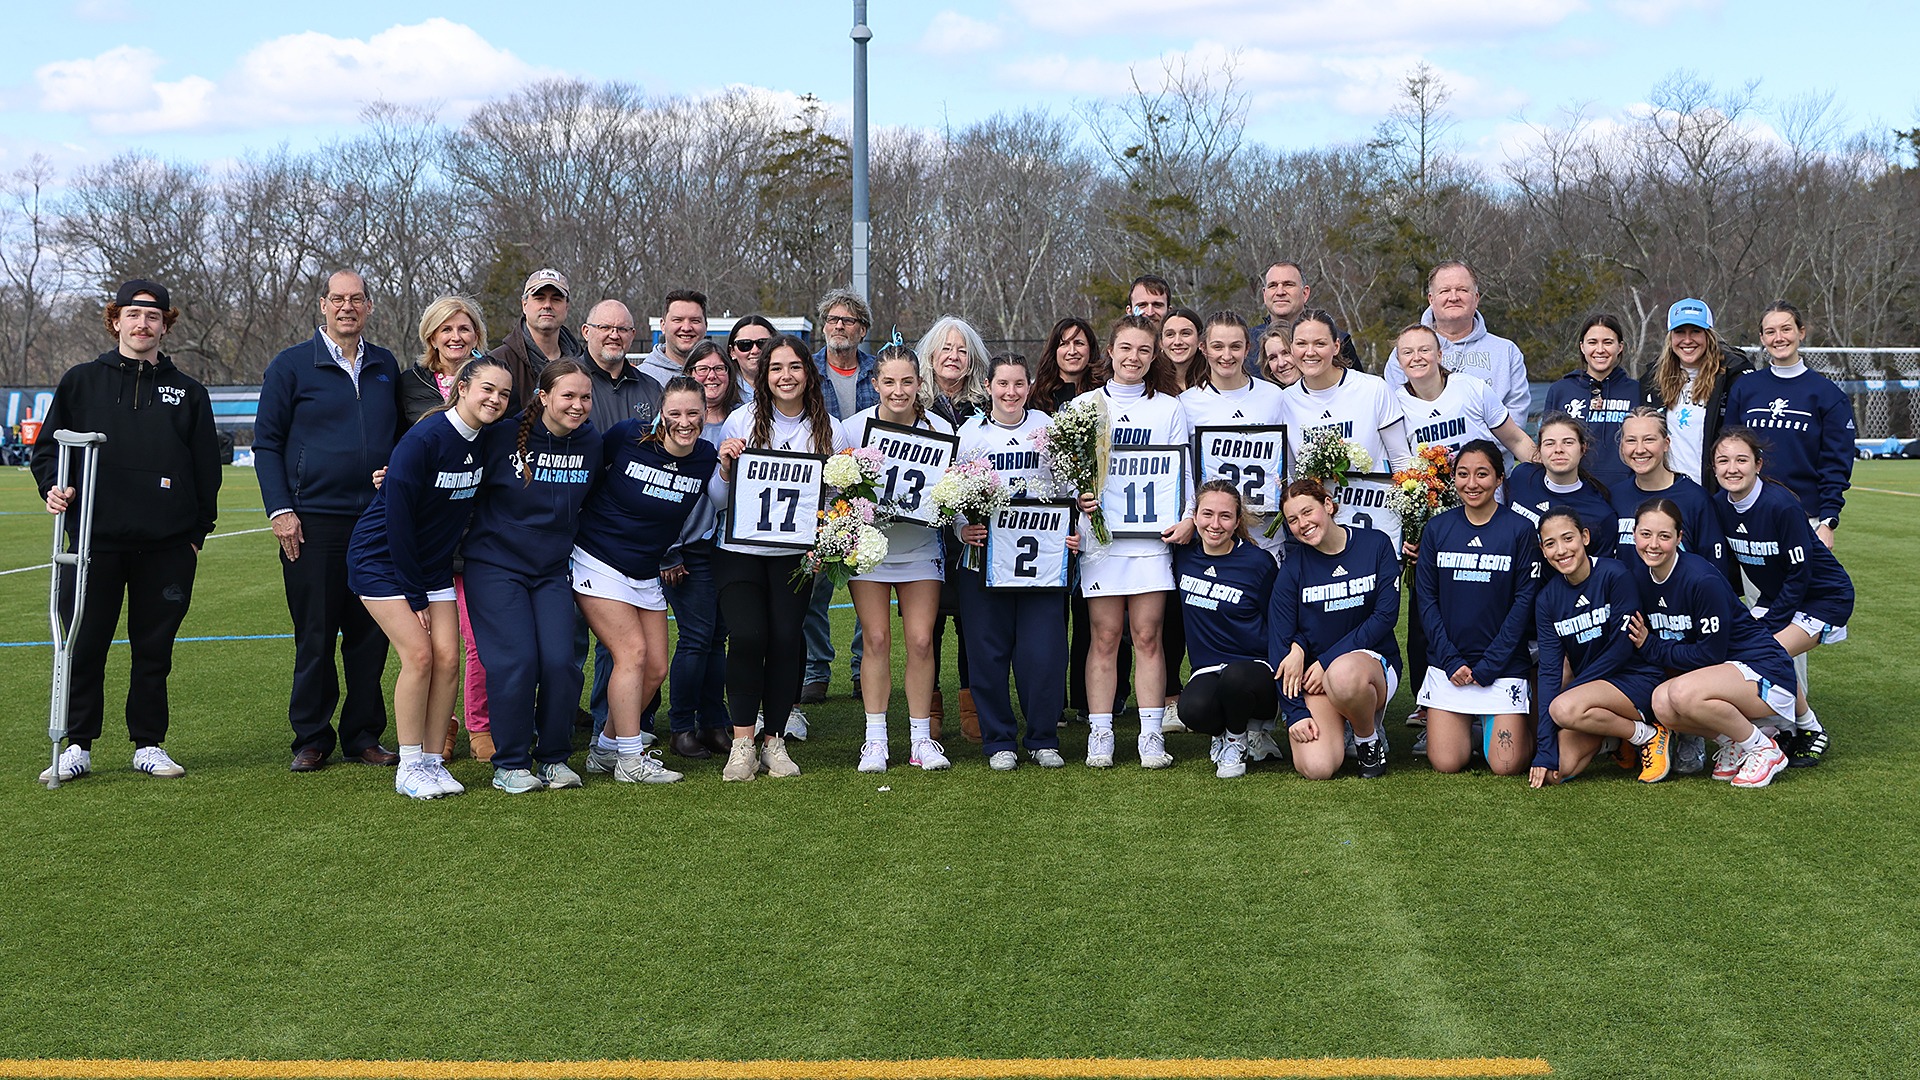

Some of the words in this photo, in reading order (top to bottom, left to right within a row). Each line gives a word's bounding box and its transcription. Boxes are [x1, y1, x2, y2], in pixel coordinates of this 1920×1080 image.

[1111, 427, 1152, 446] RDON
[1414, 416, 1467, 443] GORDON
[878, 437, 945, 467] GORDON
[1210, 438, 1274, 460] GORDON
[537, 453, 585, 469] GORDON
[747, 460, 814, 484] GORDON
[1109, 456, 1171, 476] GORDON
[434, 471, 473, 489] FIGHTING
[624, 460, 674, 489] FIGHTING
[672, 474, 703, 494] SCOTS
[879, 464, 927, 512] 13
[1123, 481, 1158, 523] 11
[1334, 487, 1389, 509] GORDO
[756, 487, 800, 532] 17
[997, 510, 1062, 531] GORDON
[1014, 535, 1039, 578] 2
[1714, 542, 1723, 559] 8
[1749, 541, 1780, 556] SCOTS
[1788, 545, 1805, 565] 10
[1436, 551, 1479, 569] FIGHTING
[1478, 554, 1512, 572] SCOTS
[1452, 569, 1492, 583] LACROSSE
[1208, 583, 1244, 605] SCOTS
[1302, 581, 1348, 604] FIGHTING
[1348, 573, 1377, 596] SCOT
[1324, 594, 1365, 613] LACROSSE
[1553, 611, 1593, 637] FIGHTING
[1620, 614, 1631, 632] 7
[1700, 616, 1720, 634] 28
[1655, 730, 1667, 755] OSAKA
